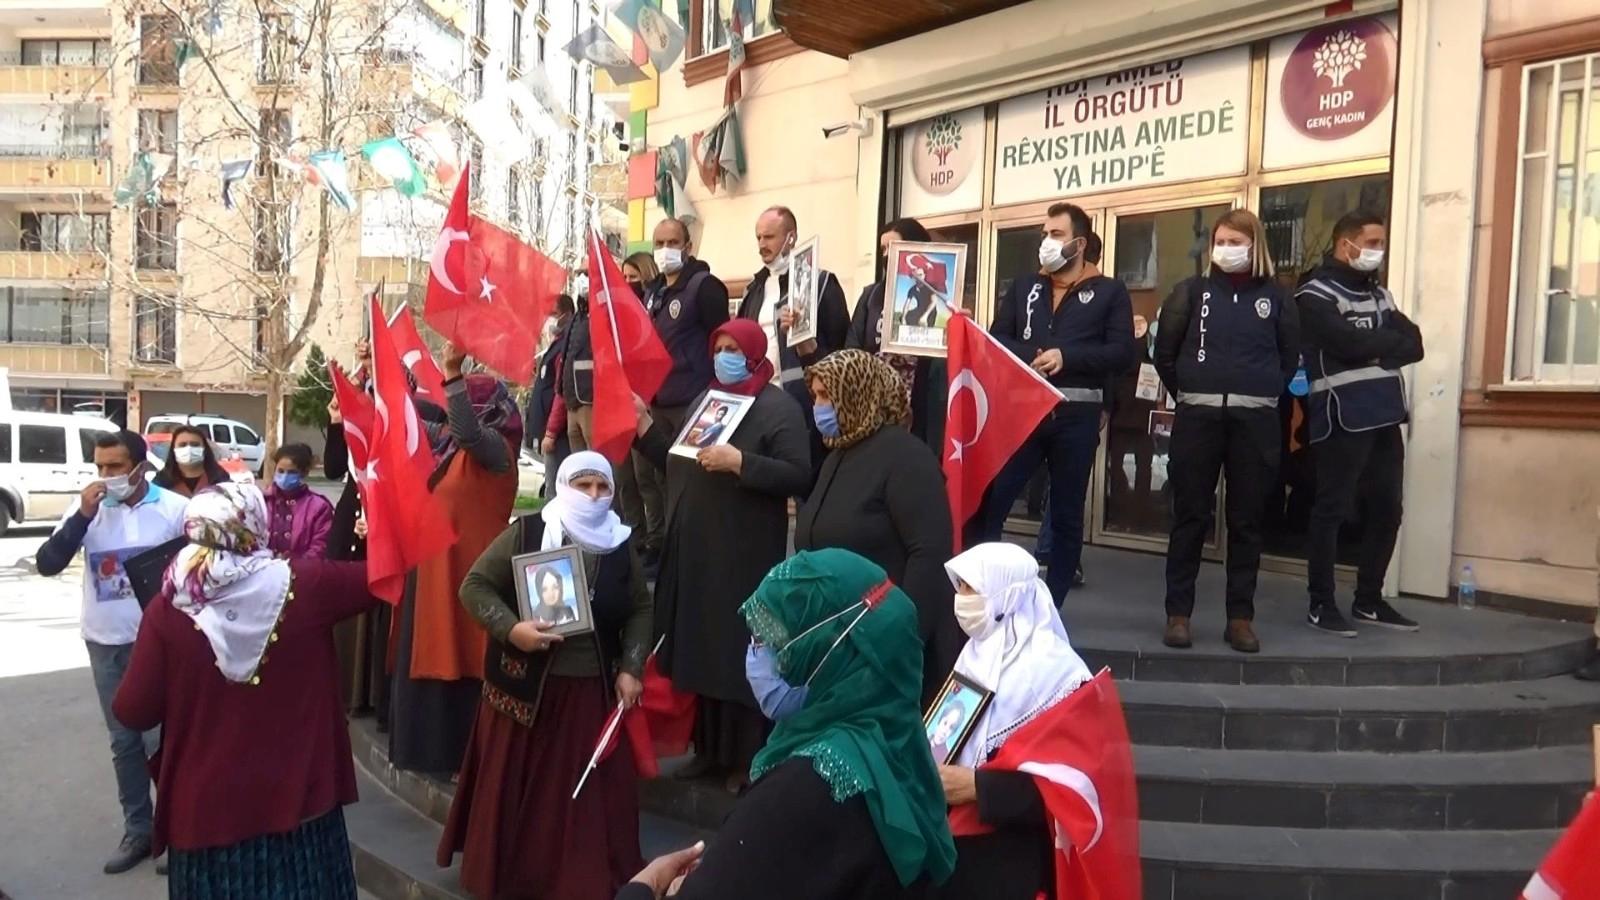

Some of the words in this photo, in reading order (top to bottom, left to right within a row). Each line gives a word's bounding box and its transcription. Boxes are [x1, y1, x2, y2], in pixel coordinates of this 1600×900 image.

[1044, 100, 1065, 129] İL
[1074, 73, 1184, 124] ÖRGÜTÜ
[1319, 90, 1354, 111] HDP
[1002, 125, 1126, 169] RÊXISTINA
[1134, 100, 1235, 148] AMEDÊ
[1306, 116, 1332, 129] GENÇ
[1334, 111, 1366, 125] KADIN
[930, 169, 954, 187] HDP
[1053, 164, 1082, 190] YA
[1091, 145, 1166, 186] HDP'Ê
